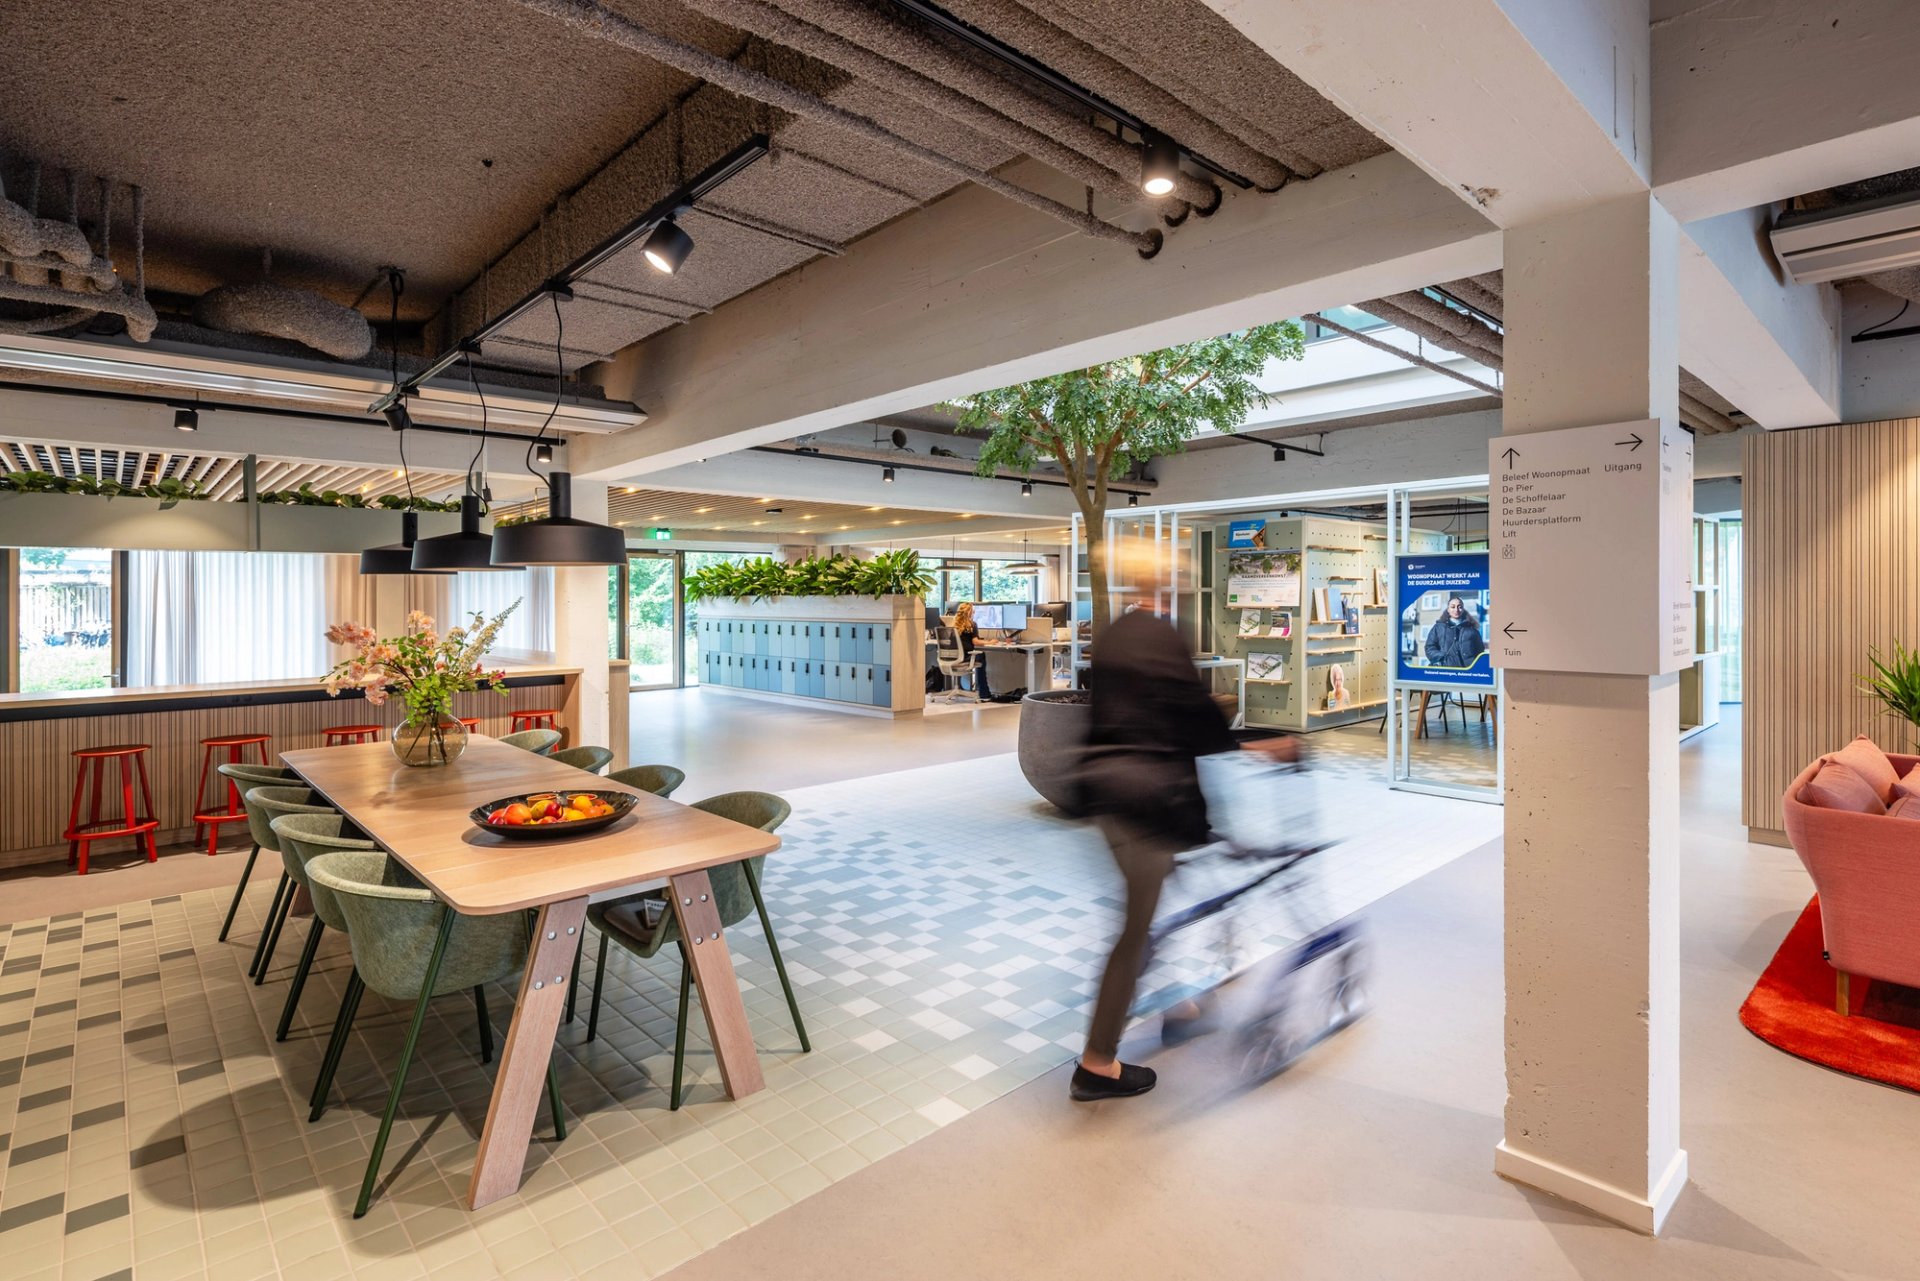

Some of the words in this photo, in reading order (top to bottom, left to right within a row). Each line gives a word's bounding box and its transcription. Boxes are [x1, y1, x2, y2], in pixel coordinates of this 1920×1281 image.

[1604, 463, 1642, 474] Uitgang
[1502, 471, 1530, 482] Beleef
[1531, 466, 1591, 479] Woonopmaat
[1502, 485, 1514, 494] De
[1515, 484, 1534, 493] Pier
[1502, 496, 1514, 505] De
[1515, 493, 1567, 504] Schoffelaar
[1502, 507, 1514, 516] De
[1515, 506, 1547, 515] Bazaar
[1502, 513, 1582, 527] Huurdersplatform
[1502, 529, 1517, 539] Lift
[1503, 647, 1522, 657] Tuin
